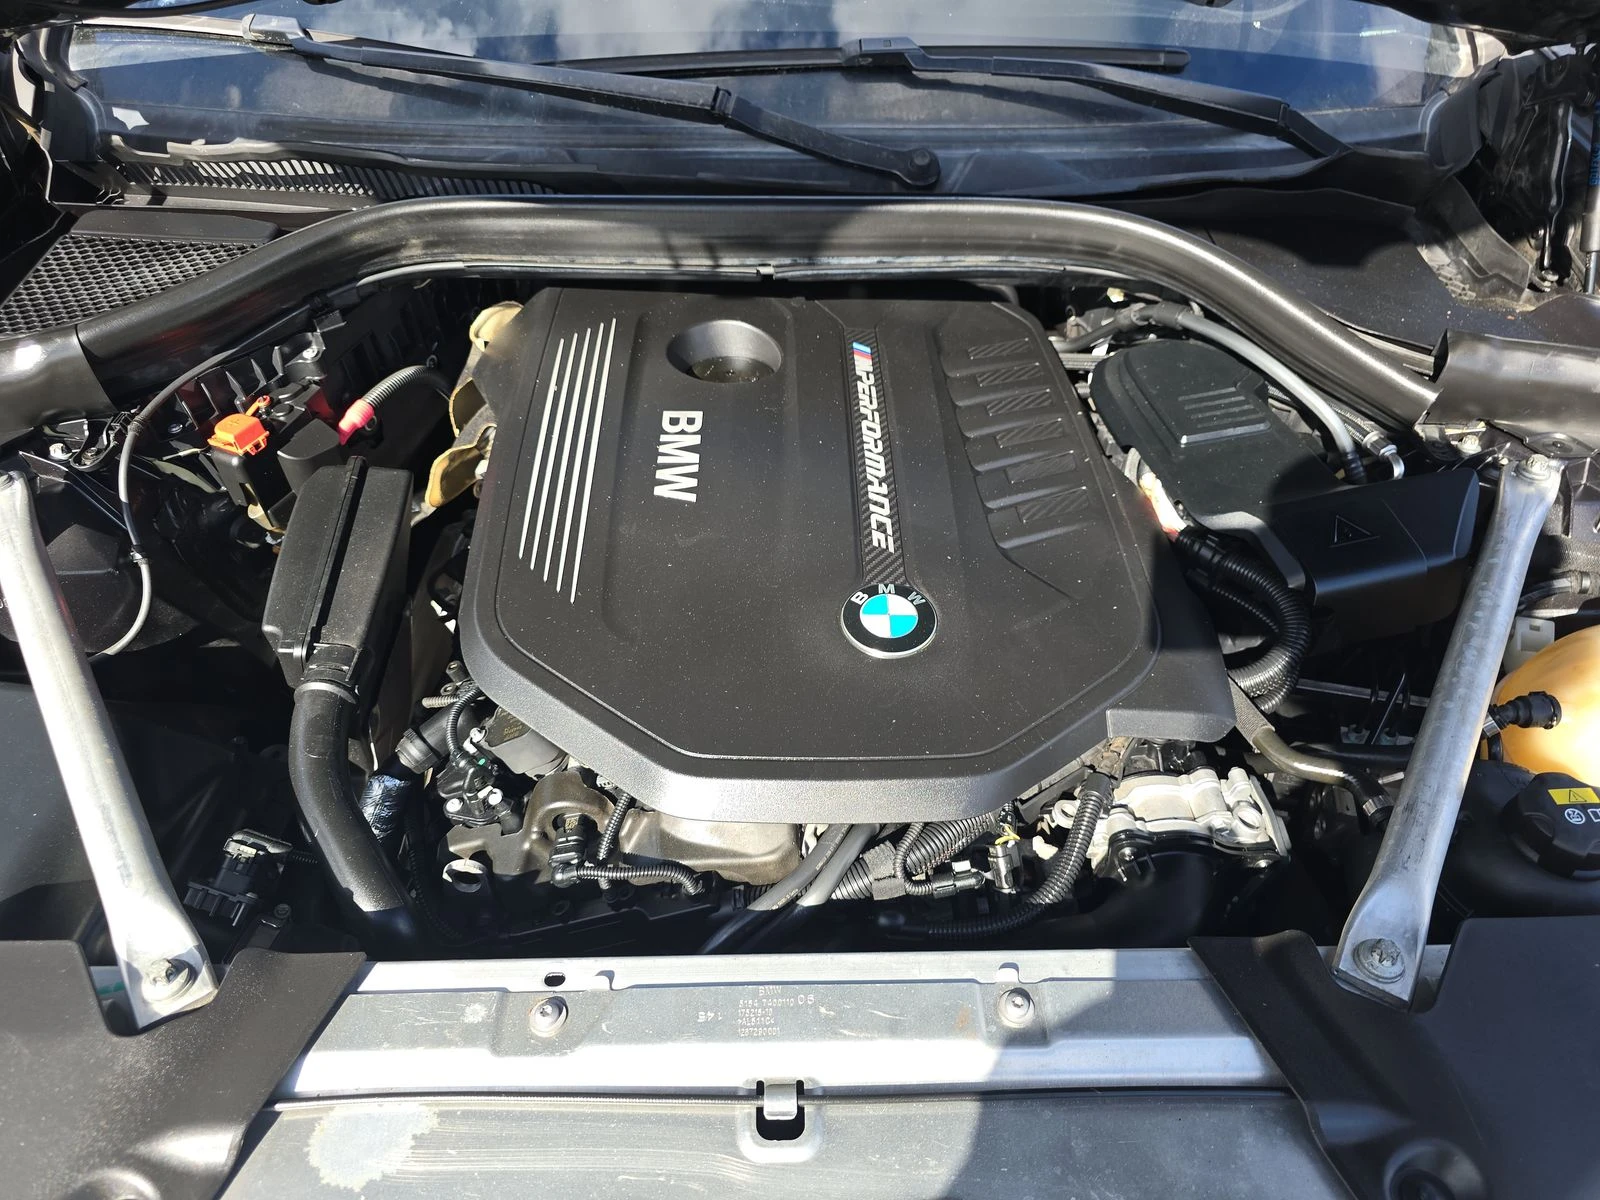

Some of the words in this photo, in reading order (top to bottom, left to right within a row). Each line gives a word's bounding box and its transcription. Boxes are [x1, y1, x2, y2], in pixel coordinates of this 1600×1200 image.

[654, 410, 703, 502] BMW
[856, 368, 895, 553] PERFORMANCE
[849, 583, 926, 606] BMW
